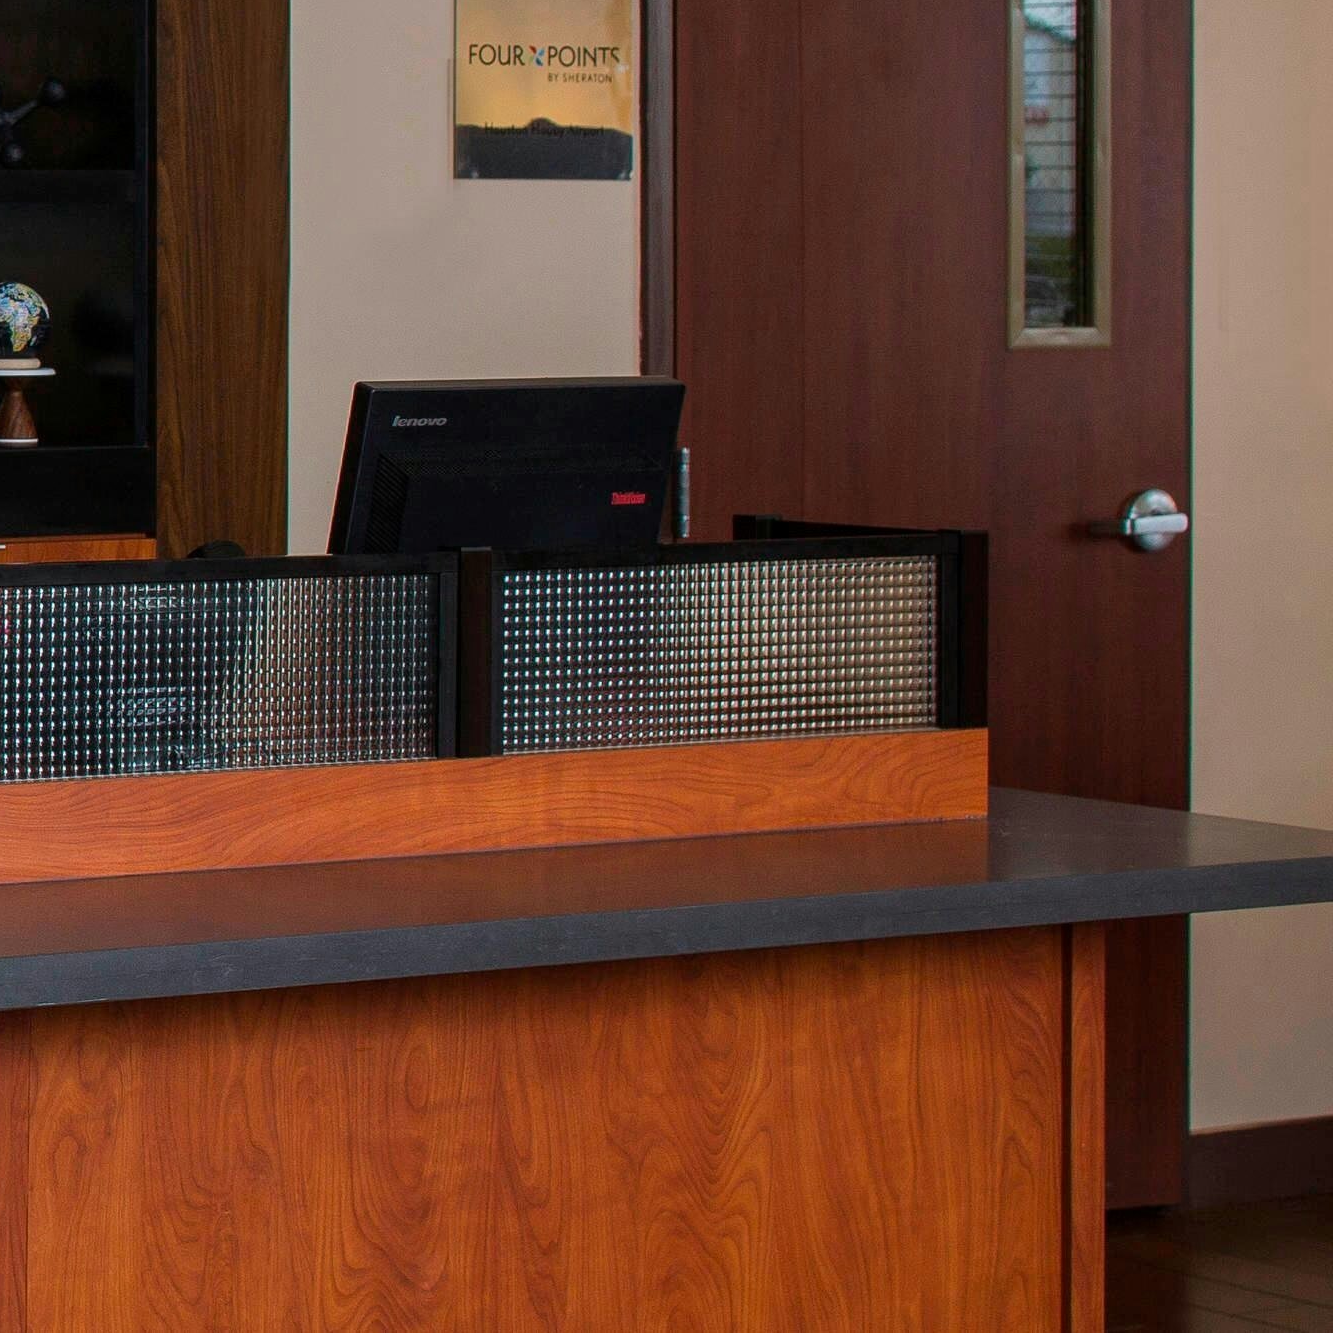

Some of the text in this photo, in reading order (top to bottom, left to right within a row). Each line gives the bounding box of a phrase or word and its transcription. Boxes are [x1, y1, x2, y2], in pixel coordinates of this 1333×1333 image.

[468, 44, 620, 67] FOUR POINTS
[548, 73, 612, 84] BY SHERATON
[391, 415, 447, 427] lenovo
